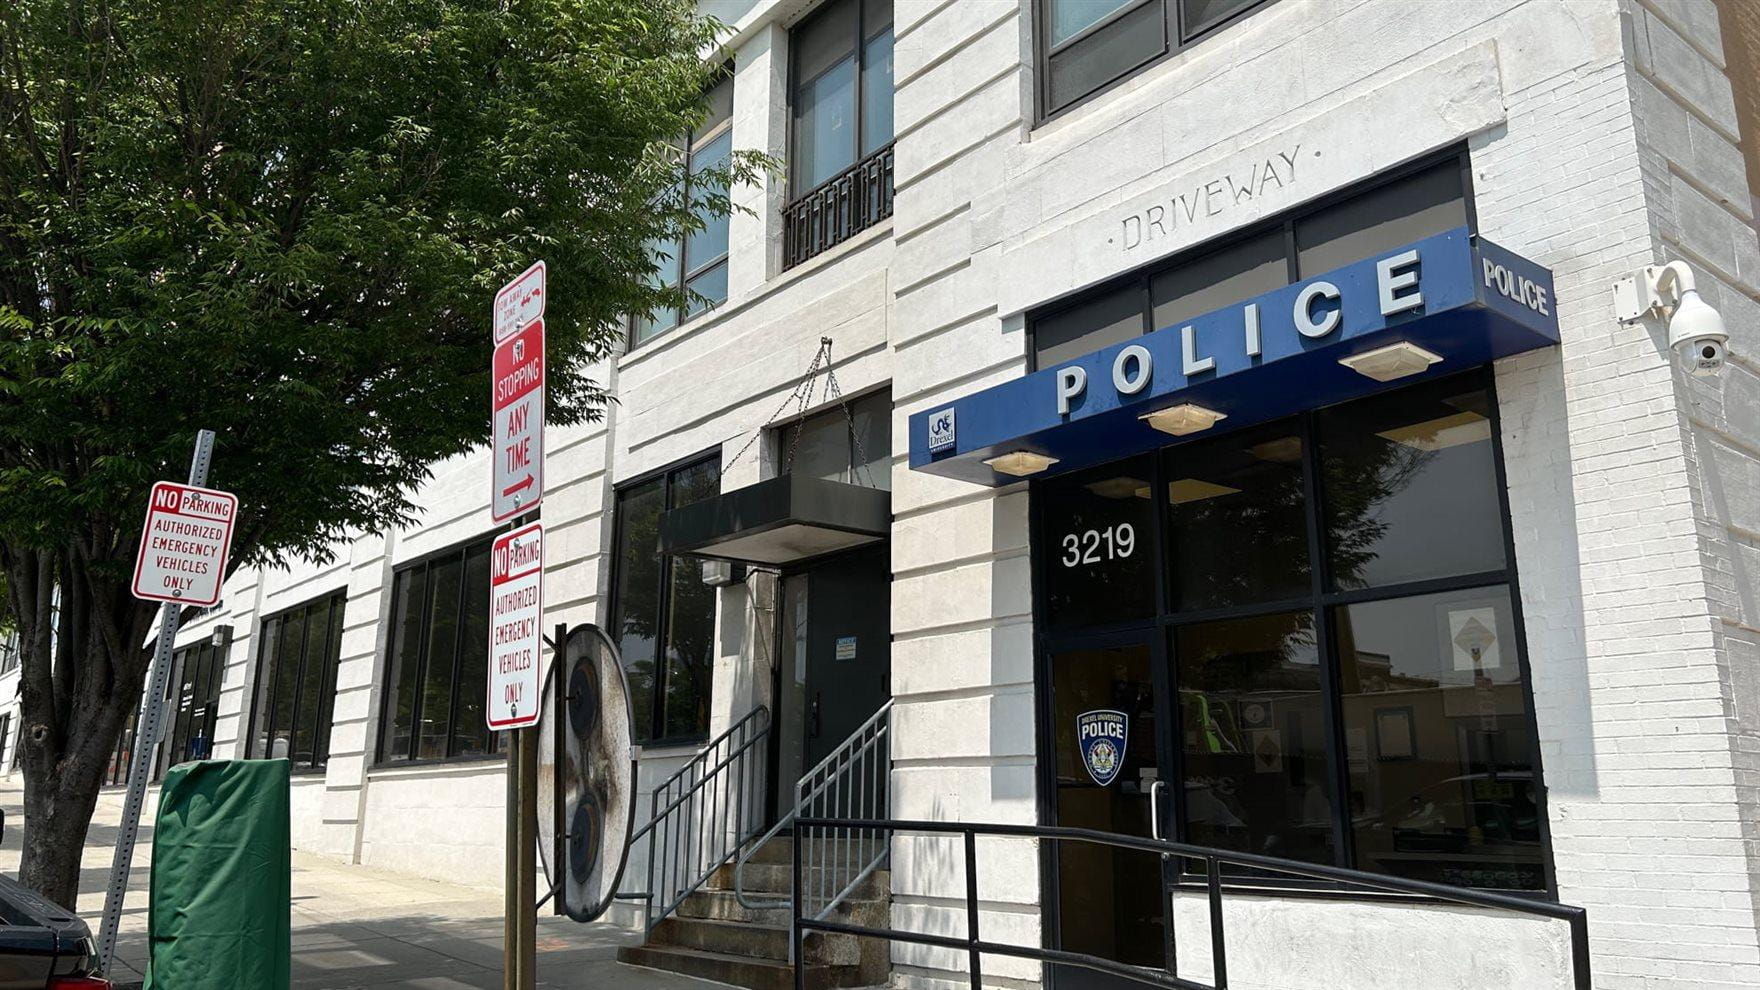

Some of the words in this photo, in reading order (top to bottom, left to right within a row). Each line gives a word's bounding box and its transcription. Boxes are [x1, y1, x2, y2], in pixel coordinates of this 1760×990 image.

[1122, 144, 1300, 251] DRIVEWAY
[1482, 257, 1549, 316] POLICE
[1056, 249, 1424, 415] POLICE
[512, 339, 525, 365] NO
[498, 358, 539, 402] STOPPING
[507, 401, 530, 440] ANY
[930, 429, 953, 446] Drexel
[505, 438, 531, 475] TIME
[156, 488, 178, 509] NO
[182, 496, 230, 516] PARKING
[154, 519, 223, 541] AUTHORIZED
[152, 536, 218, 558] EMERGENCY
[494, 546, 506, 578] NO
[510, 538, 540, 569] PARKING
[1062, 523, 1135, 567] 3219
[156, 555, 208, 575] VEHICLES
[163, 575, 193, 590] ONLY
[495, 585, 537, 616] AUTHORIZED
[495, 616, 535, 646] EMERGENCY
[498, 648, 531, 675] VEHICLES
[505, 681, 523, 704] ONLY
[1081, 721, 1124, 740] POLICE
